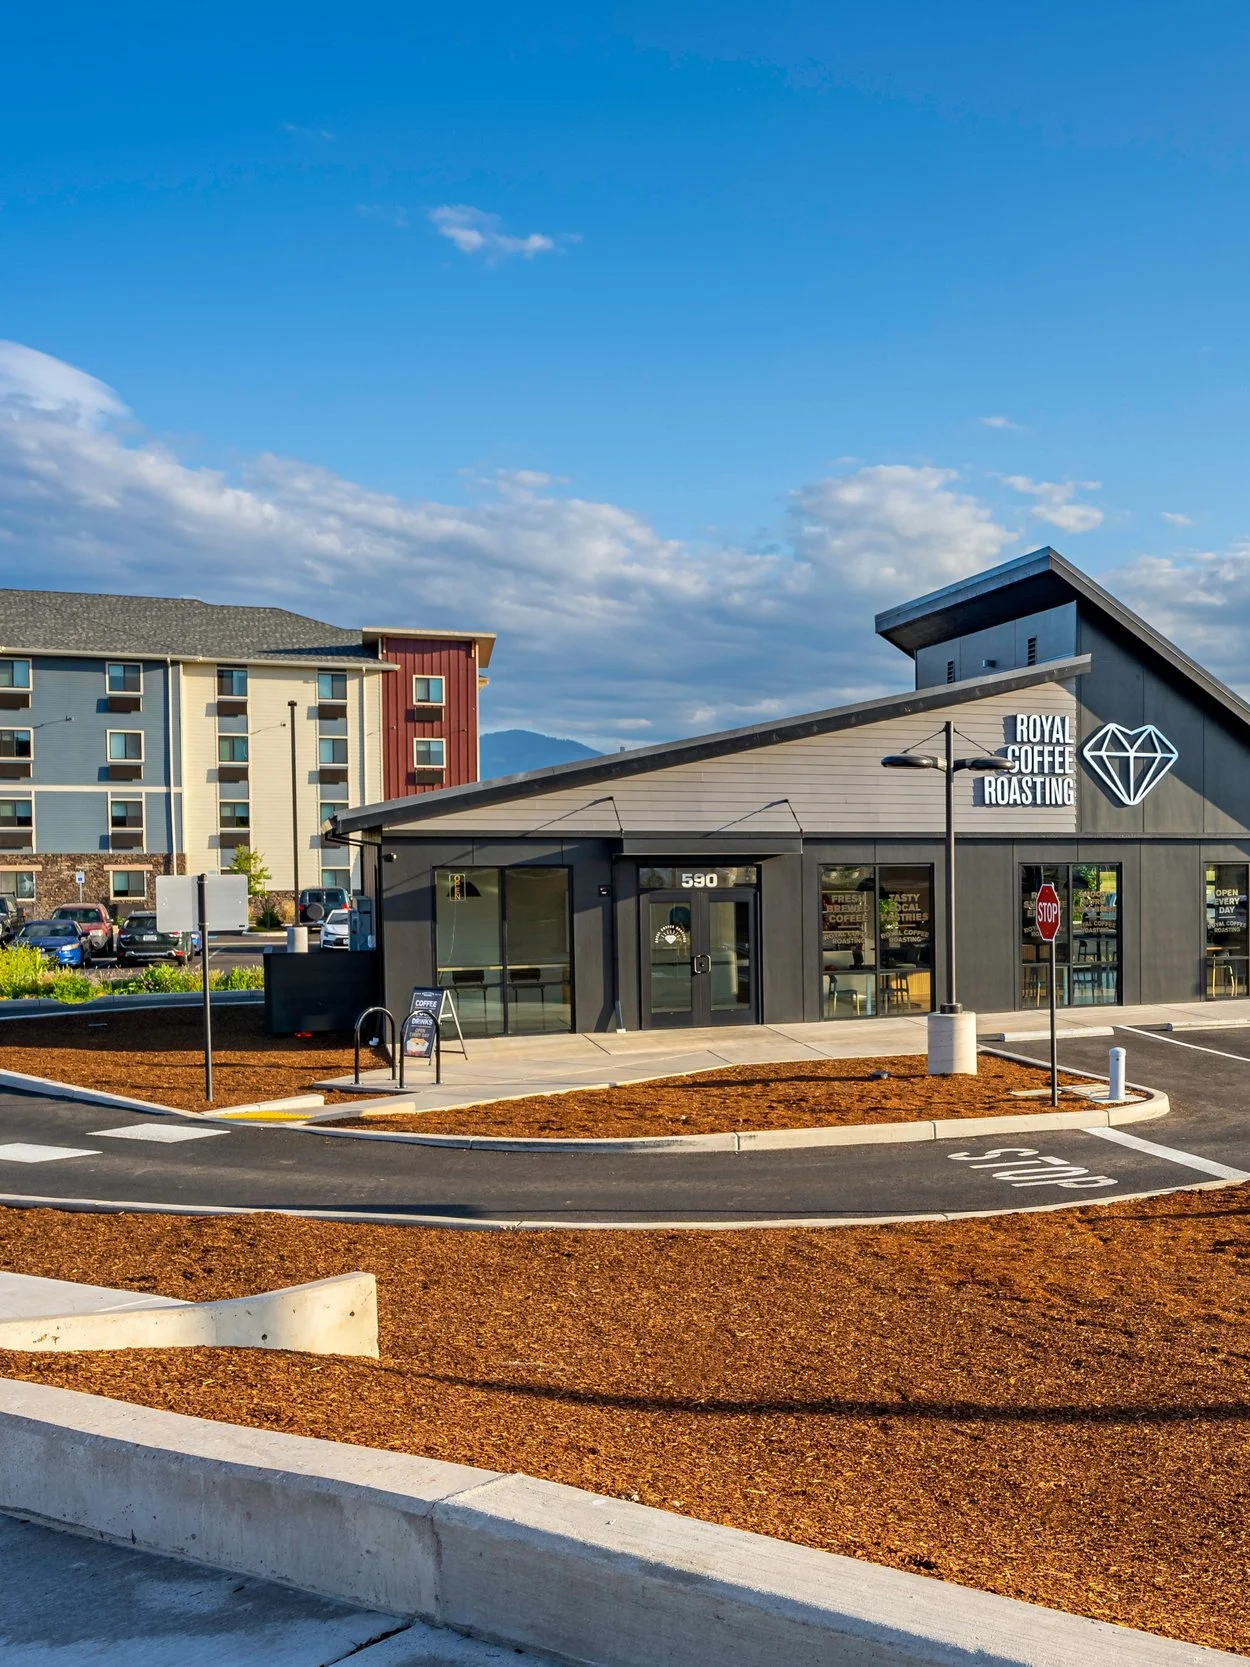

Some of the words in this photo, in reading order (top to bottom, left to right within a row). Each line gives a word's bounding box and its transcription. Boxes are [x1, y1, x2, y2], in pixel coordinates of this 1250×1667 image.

[1015, 714, 1074, 744] ROYAL
[1007, 745, 1074, 774] COFFEE
[984, 776, 1075, 805] ROASTING
[681, 873, 718, 888] 590
[888, 893, 920, 902] TASTY
[1215, 889, 1239, 897] OPEN
[831, 894, 866, 903] FRESH
[1214, 897, 1241, 906] EVERY
[826, 904, 870, 913] BREWED
[889, 903, 921, 912] LOCAL
[1218, 906, 1236, 914] DAY
[1038, 902, 1058, 923] STOP
[828, 914, 869, 923] COFFEE
[880, 913, 929, 922] PASTRIES
[1225, 920, 1248, 929] COFFEE
[880, 930, 903, 940] ROYAL
[903, 929, 930, 938] COFFEE
[832, 937, 866, 945] ROASTING
[415, 1000, 438, 1008] COFFEE
[411, 1018, 433, 1026] DRINKS
[947, 1148, 1118, 1188] STOP
